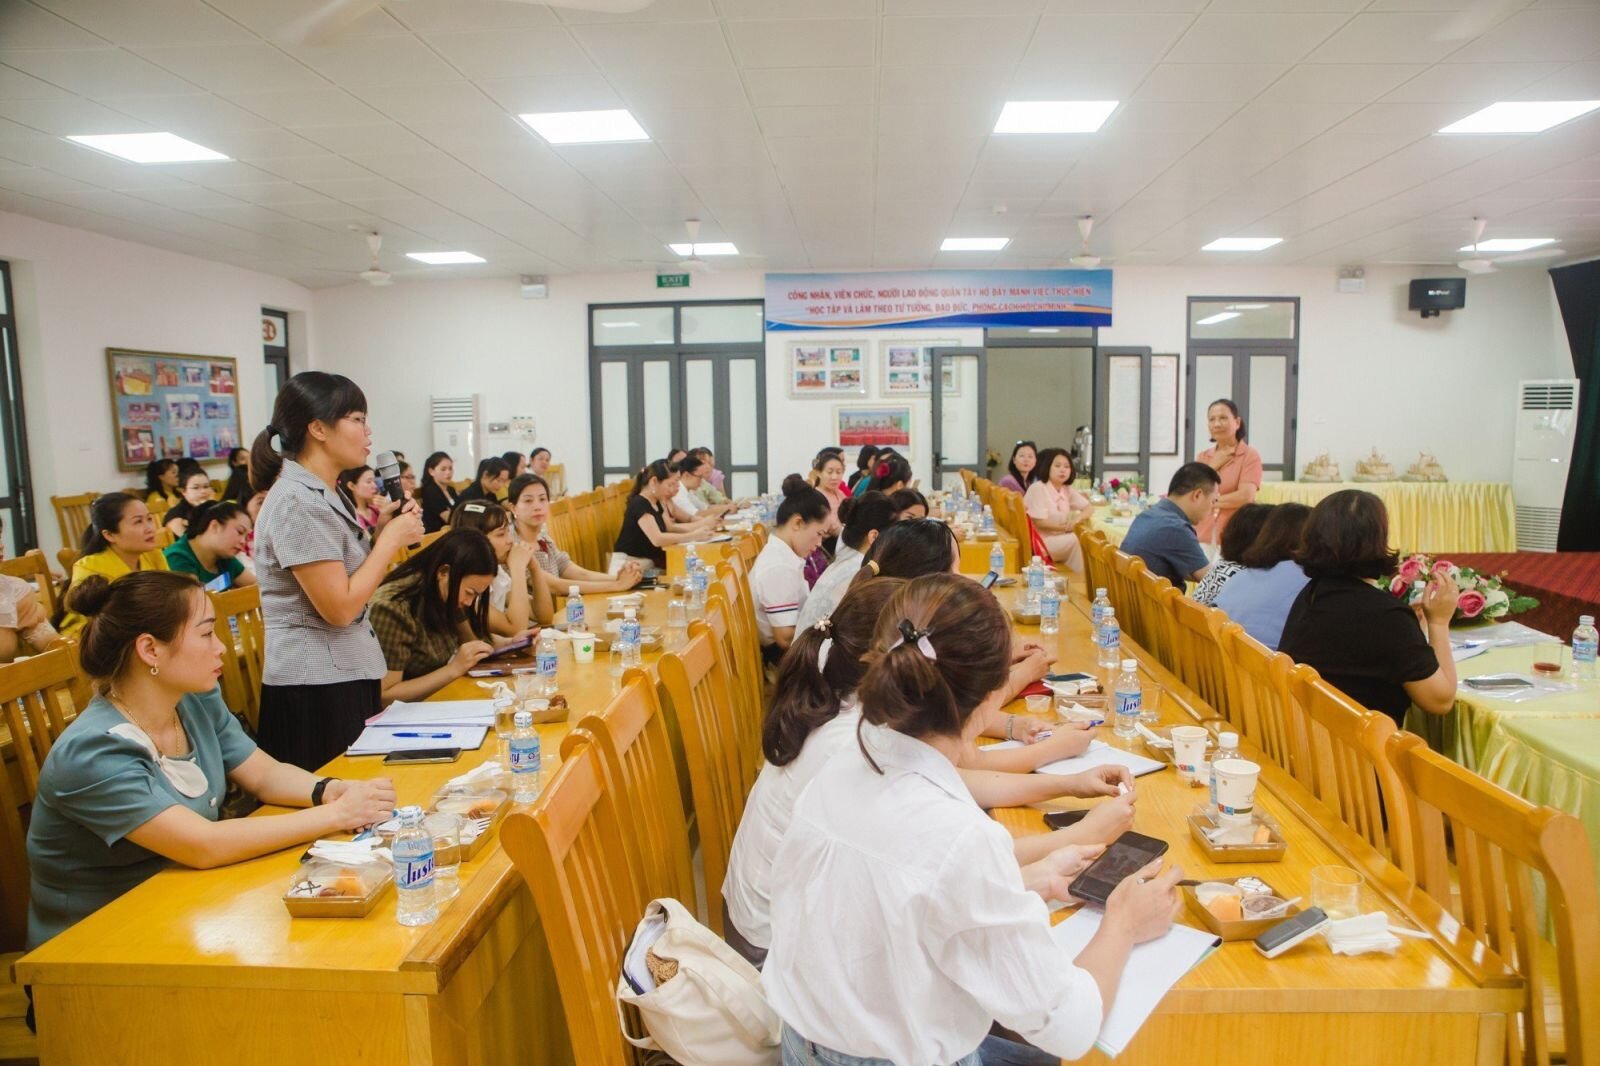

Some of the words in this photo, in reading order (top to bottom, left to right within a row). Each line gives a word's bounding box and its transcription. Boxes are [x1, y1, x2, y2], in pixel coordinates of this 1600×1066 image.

[662, 275, 684, 283] EXIT
[902, 287, 916, 297] LAO
[874, 302, 893, 313] THEO
